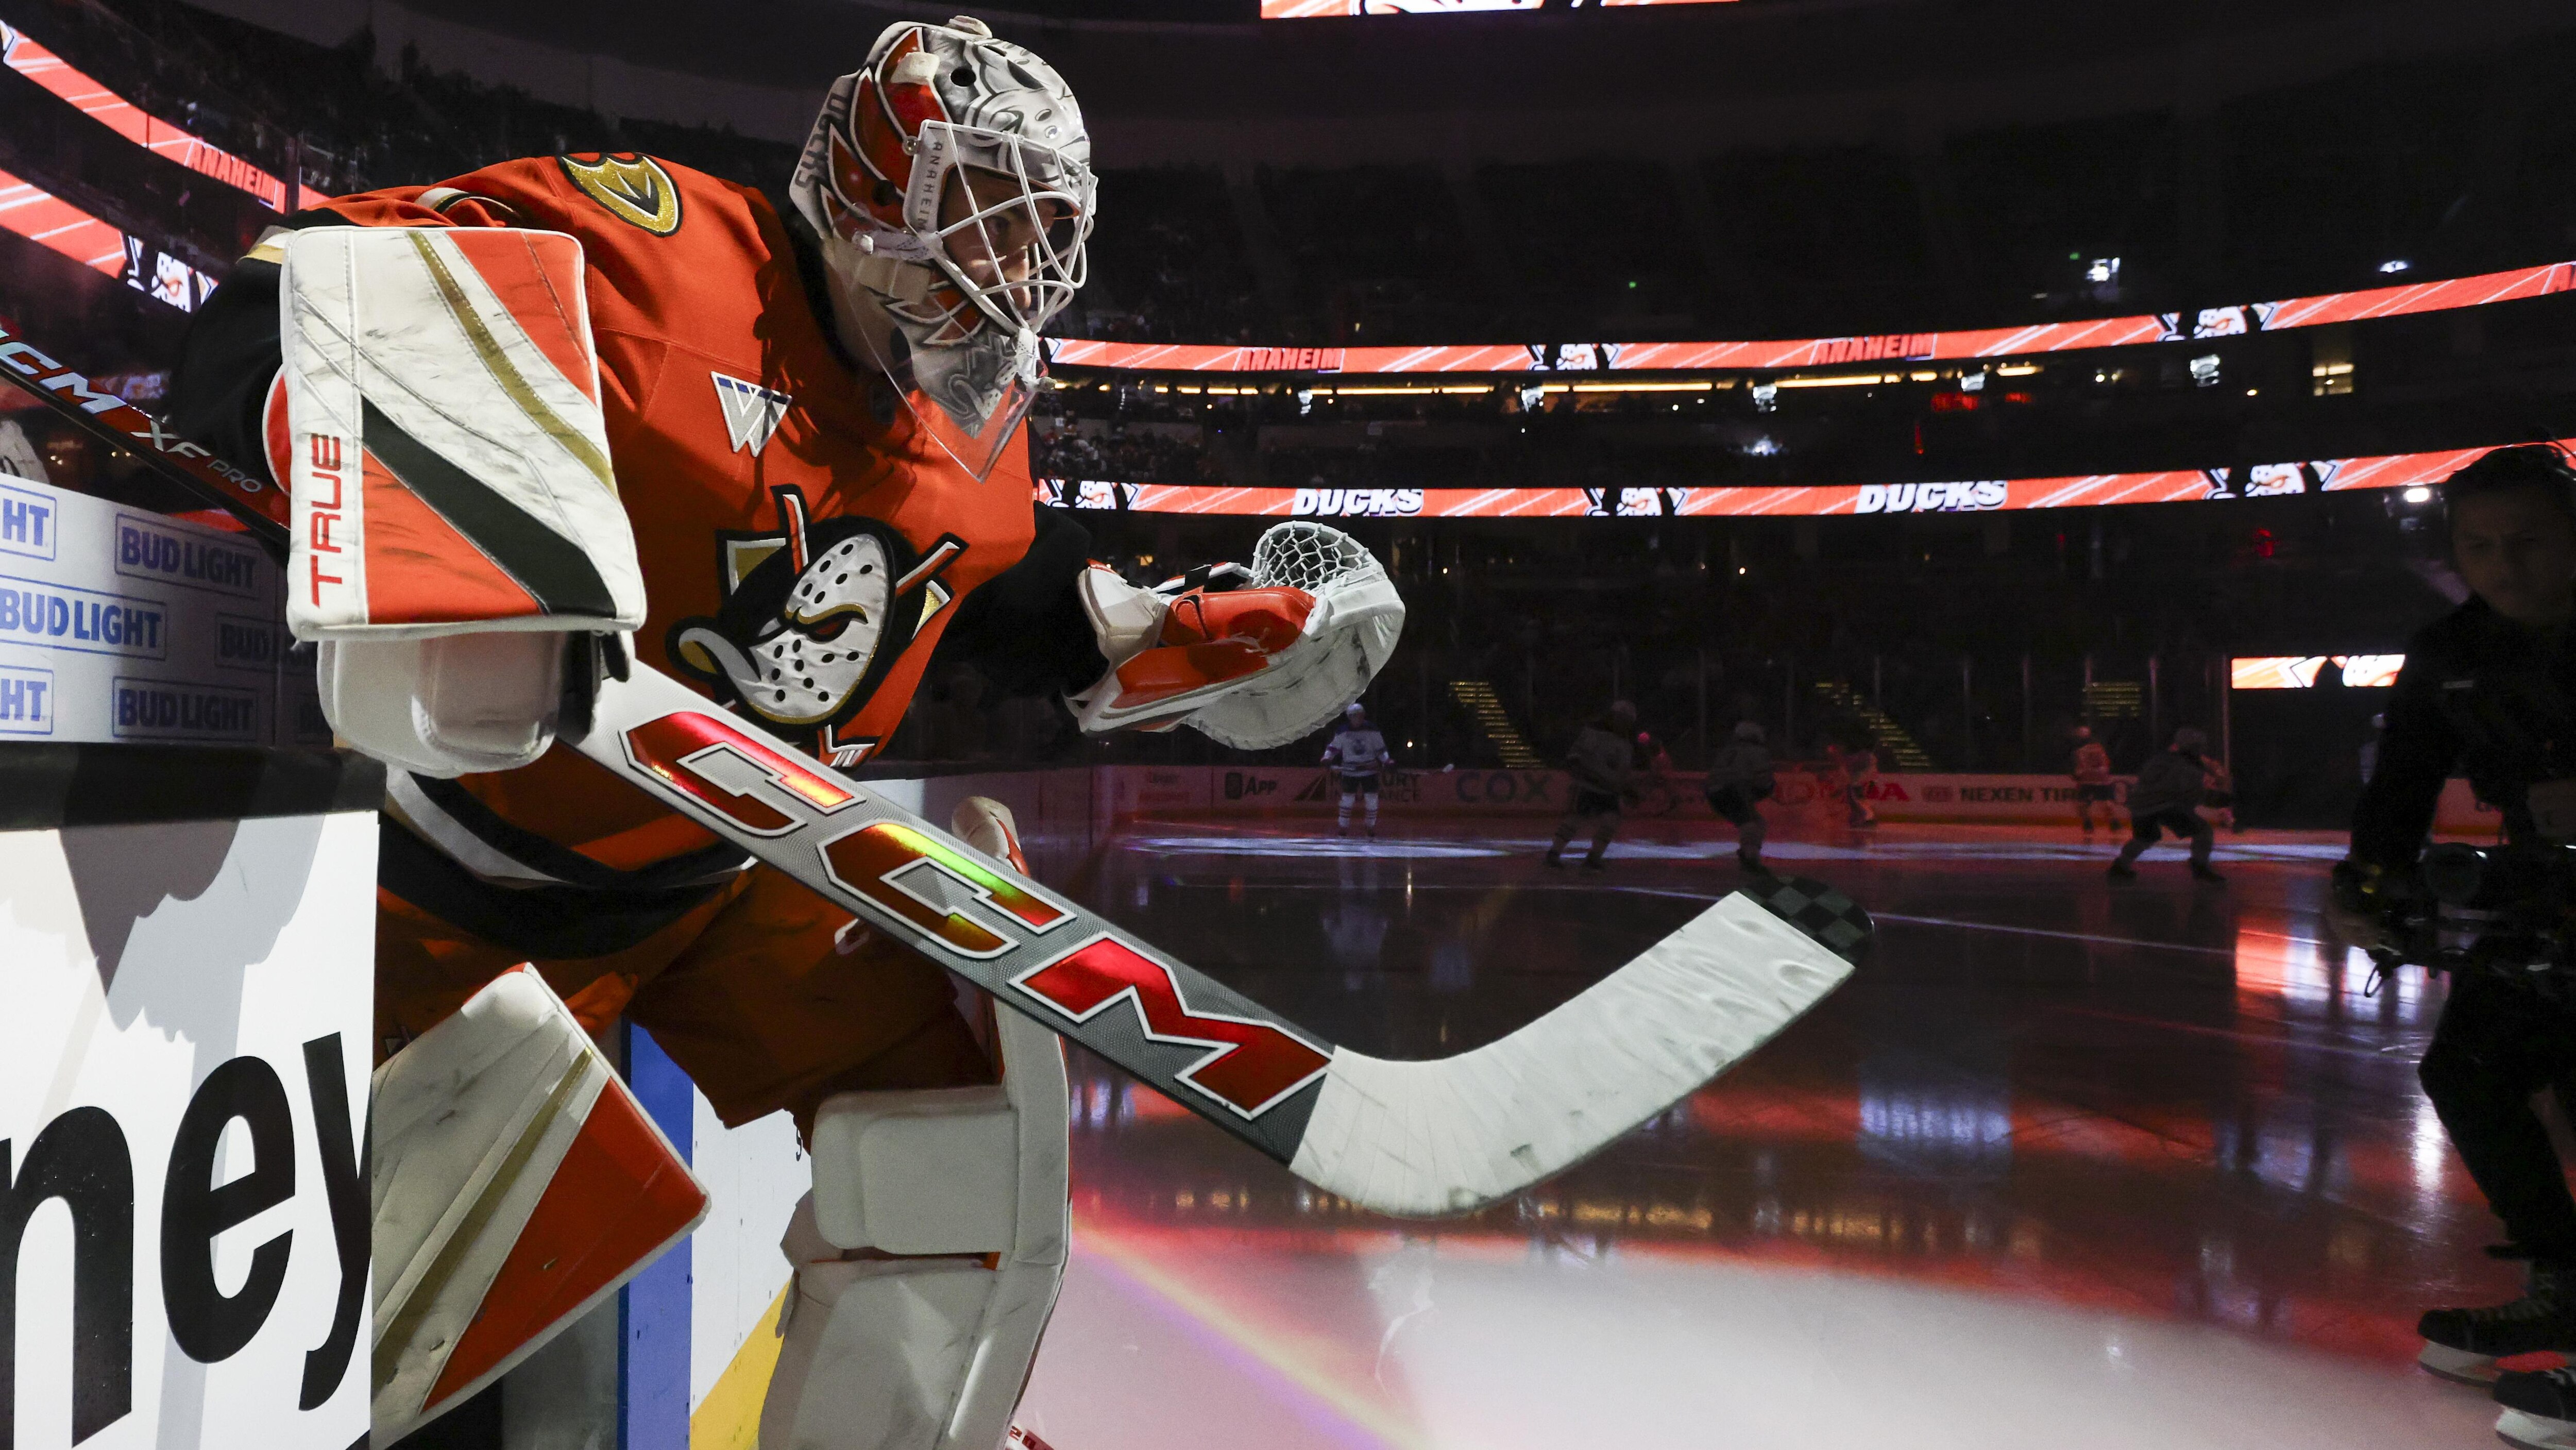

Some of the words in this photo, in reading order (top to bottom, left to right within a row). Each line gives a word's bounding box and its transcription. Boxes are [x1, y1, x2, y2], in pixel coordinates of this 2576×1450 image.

[187, 139, 276, 205] ANAHEIM
[917, 141, 943, 230] ANAHEIM
[1235, 347, 1341, 372] ANAHEIM
[1812, 332, 1932, 365] ANAHEIM
[0, 328, 127, 414] CM
[207, 459, 262, 493] PRO
[1855, 481, 2006, 514] DUCKS
[310, 432, 342, 609] TRUE
[1291, 488, 1424, 516] DUCKS
[122, 526, 180, 572] BUD
[184, 542, 257, 589] LIGHT
[0, 588, 69, 636] BUD
[75, 600, 162, 649] LIGHT
[119, 688, 178, 727] BUD
[181, 694, 254, 731] LIGHT
[1456, 771, 1551, 802] COX
[1961, 787, 2033, 802] NEXEN
[2041, 787, 2079, 802] TIR
[619, 711, 1335, 1120] CCM
